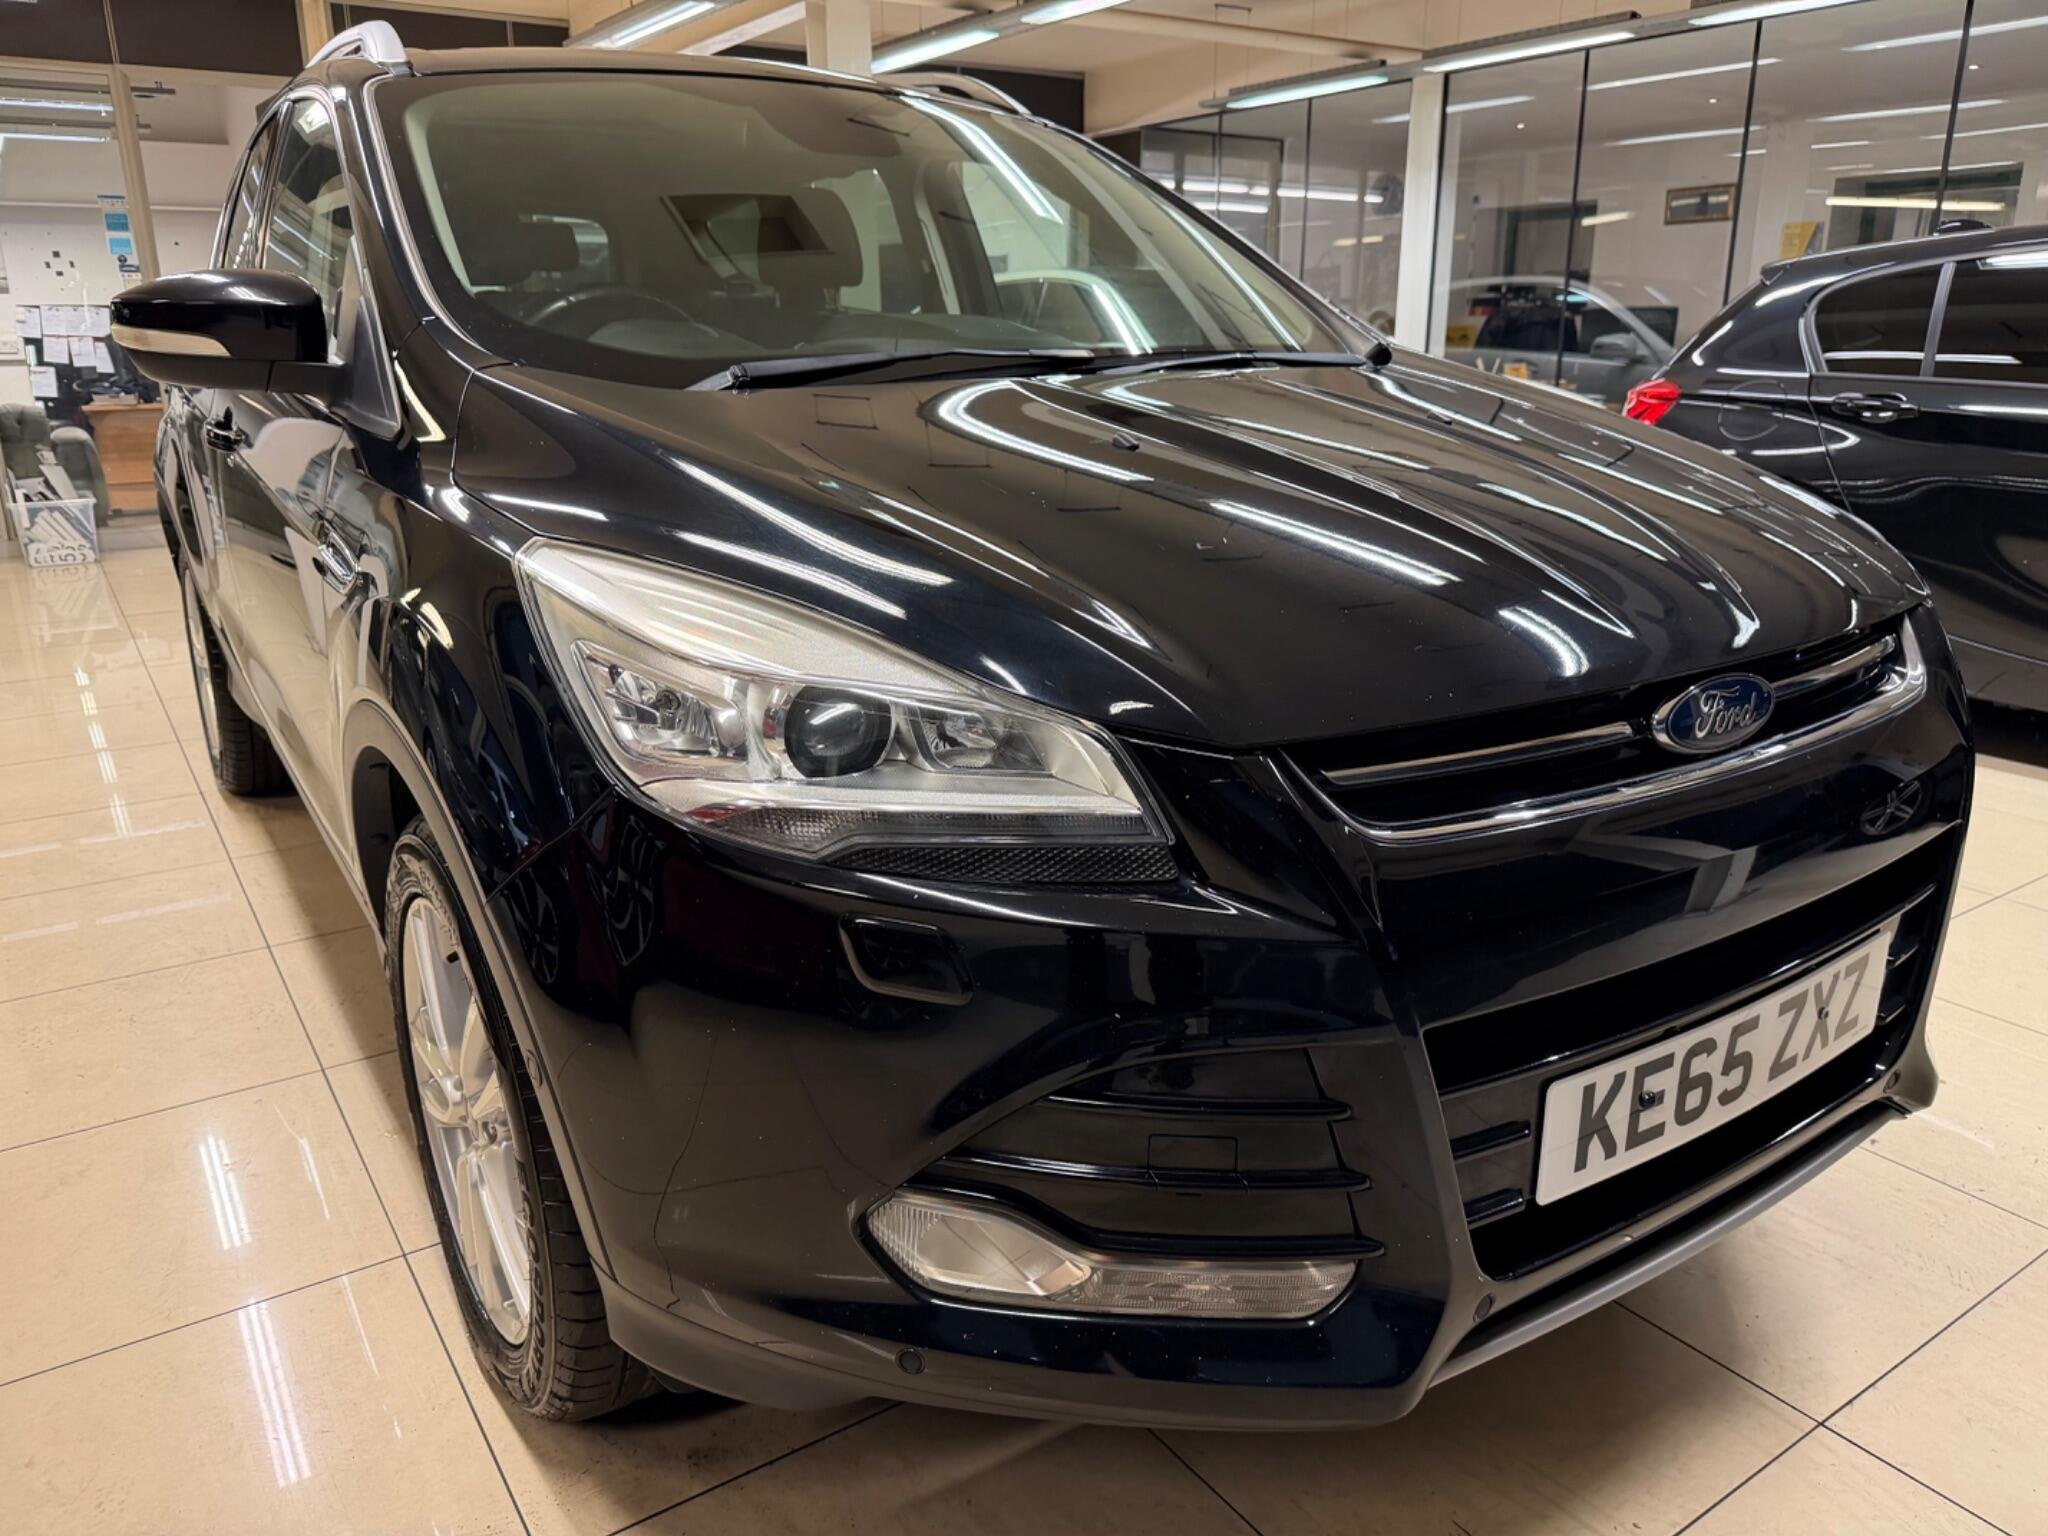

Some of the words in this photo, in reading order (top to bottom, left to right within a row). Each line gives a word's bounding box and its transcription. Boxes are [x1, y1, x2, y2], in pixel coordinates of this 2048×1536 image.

[1694, 685, 1758, 738] Ford
[1573, 1014, 1760, 1174] KE65
[1767, 952, 1870, 1083] ZXZ
